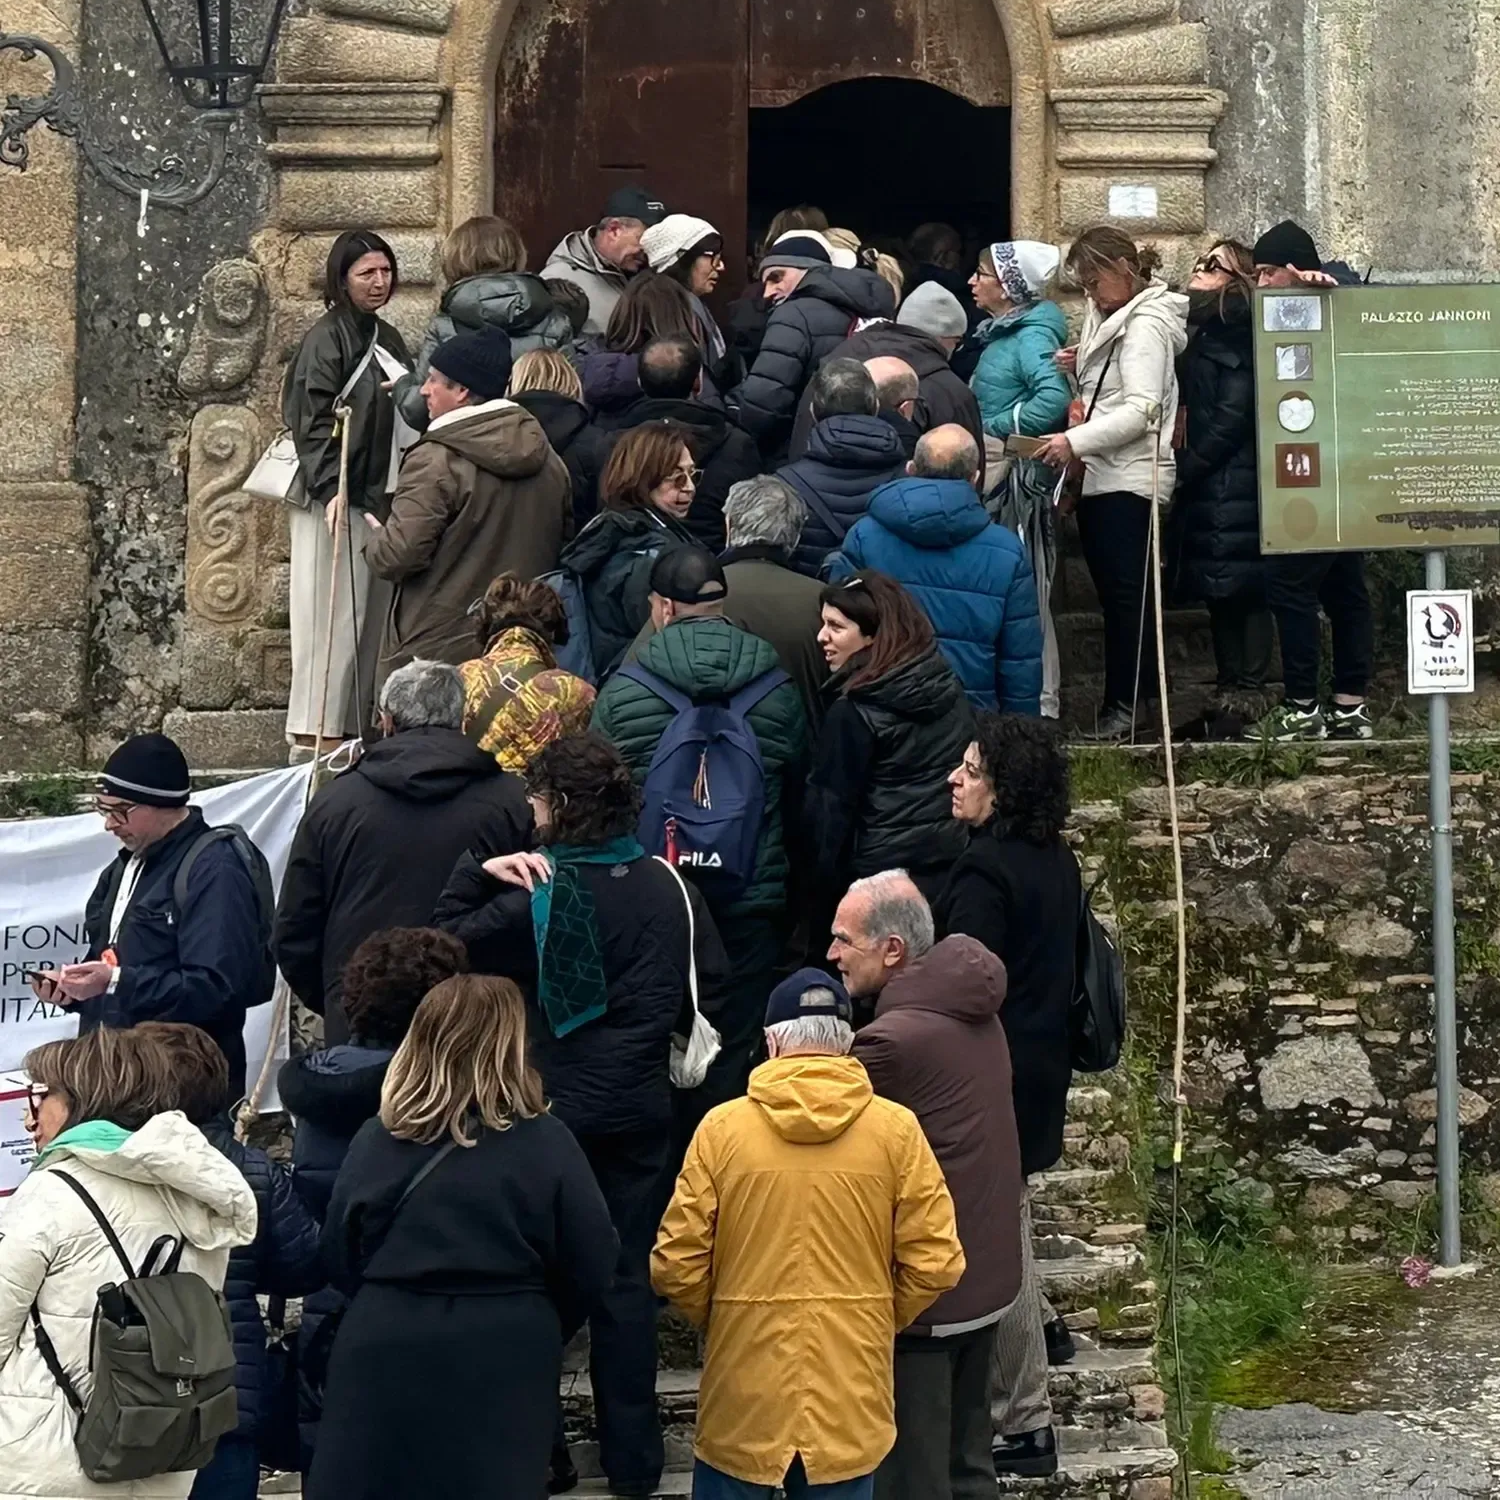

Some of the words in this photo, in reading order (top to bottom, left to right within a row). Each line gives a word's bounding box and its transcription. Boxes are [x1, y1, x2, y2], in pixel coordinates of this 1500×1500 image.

[1361, 310, 1424, 324] PALAZZO
[1427, 308, 1491, 322] JANNONI
[678, 851, 723, 867] FILA
